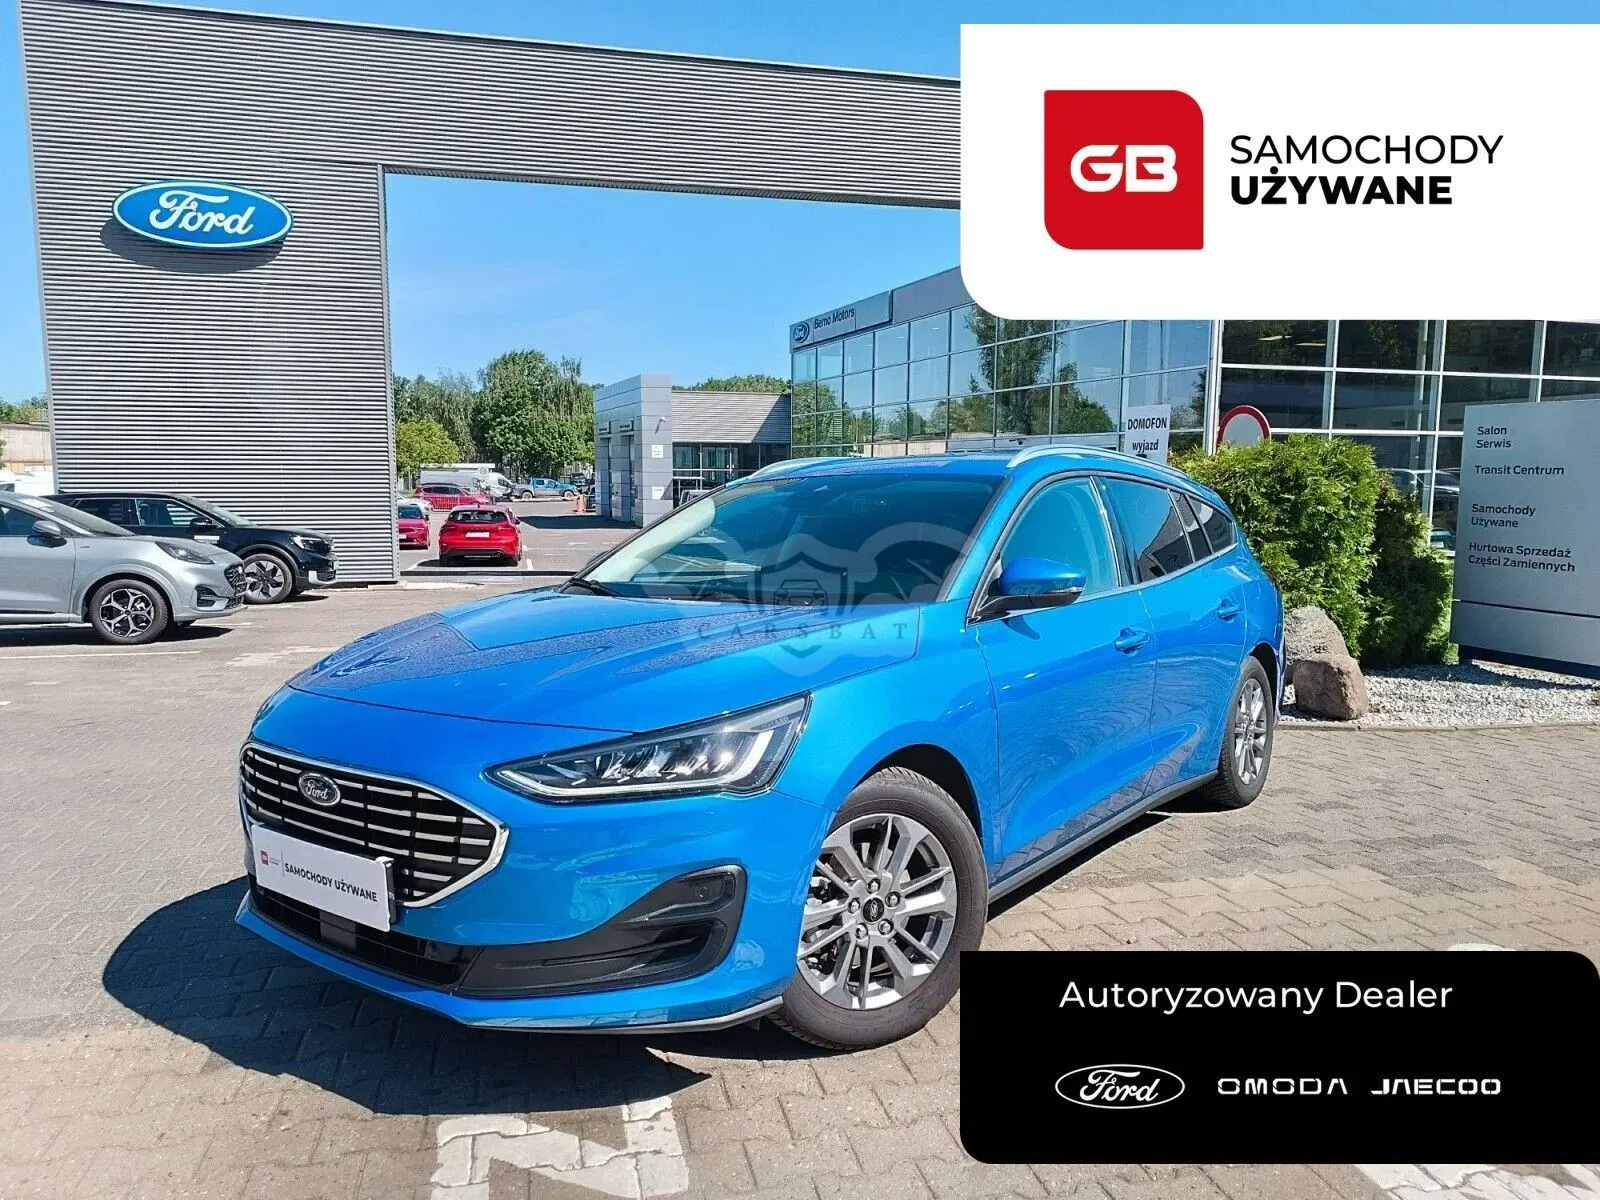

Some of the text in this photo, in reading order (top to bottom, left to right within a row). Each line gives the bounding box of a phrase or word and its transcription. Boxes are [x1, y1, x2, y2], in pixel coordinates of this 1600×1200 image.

[149, 190, 257, 235] Ford
[832, 308, 855, 324] Motors
[1127, 416, 1168, 431] DOMOFON
[1477, 425, 1508, 436] Salon
[1132, 438, 1159, 454] wyjazd
[1475, 438, 1512, 449] Serwis
[1474, 464, 1565, 476] Transit Centrum
[1471, 503, 1537, 517] Samochody
[1470, 516, 1519, 529] Używane
[1468, 541, 1572, 559] Hurtowa Sprzedaż
[1467, 554, 1576, 573] Części Zamiennych
[304, 778, 329, 801] Ford
[284, 862, 378, 902] SAMOCHODY UŻYWANE
